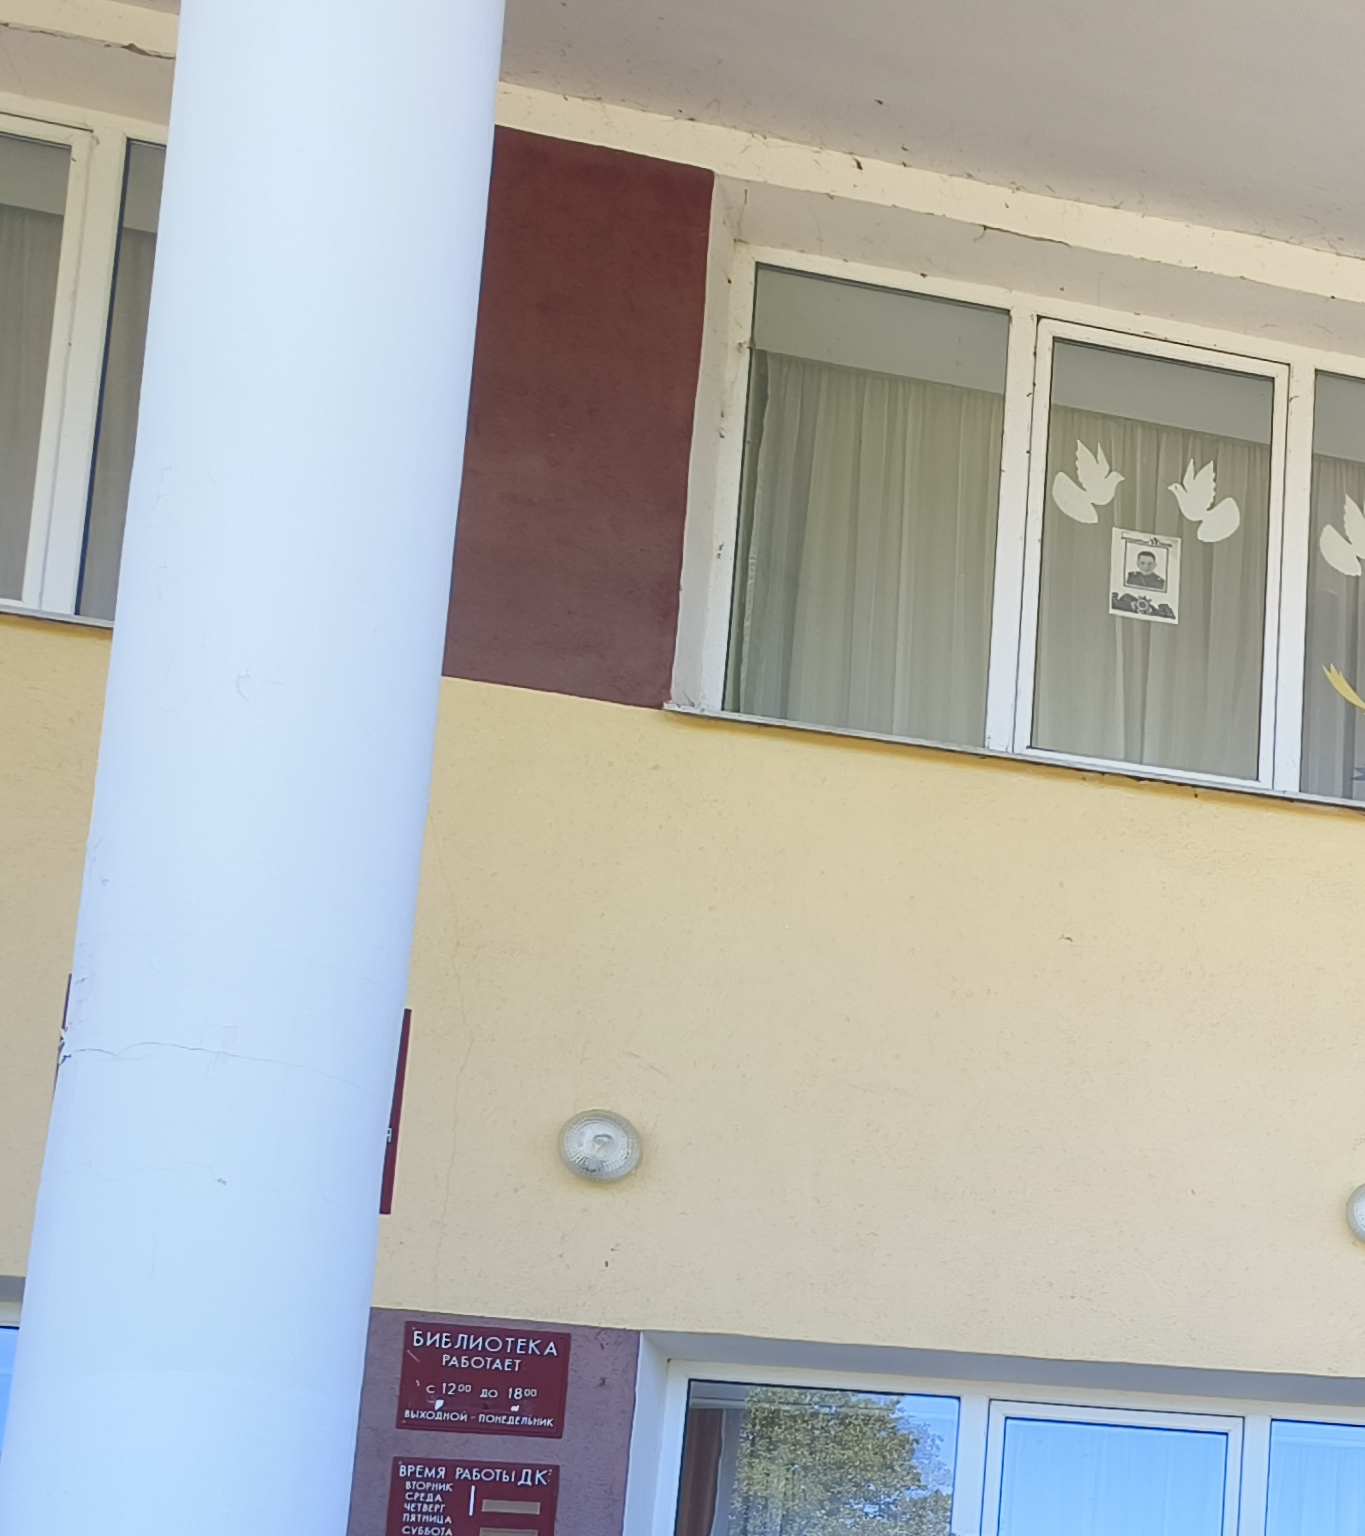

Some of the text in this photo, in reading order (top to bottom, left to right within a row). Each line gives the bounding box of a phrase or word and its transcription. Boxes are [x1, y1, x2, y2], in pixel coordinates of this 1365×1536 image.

[413, 1330, 558, 1356] БИБЛИОТЕКА
[442, 1354, 522, 1372] РАБОТАЕТ
[404, 1409, 468, 1422] ВЫХОДНОЙ
[478, 1413, 554, 1427] ПОНЕДЕЛЬНИК
[399, 1464, 549, 1486] ВРЕМЯ РАБОТЫ ДК
[405, 1481, 454, 1492] ВТОРНИК
[405, 1491, 443, 1503] СРЕДА
[403, 1502, 446, 1513] ЧЕТВЕРГ
[402, 1513, 452, 1525] ПЯТНИЦА
[401, 1525, 453, 1536] СУББОТА
